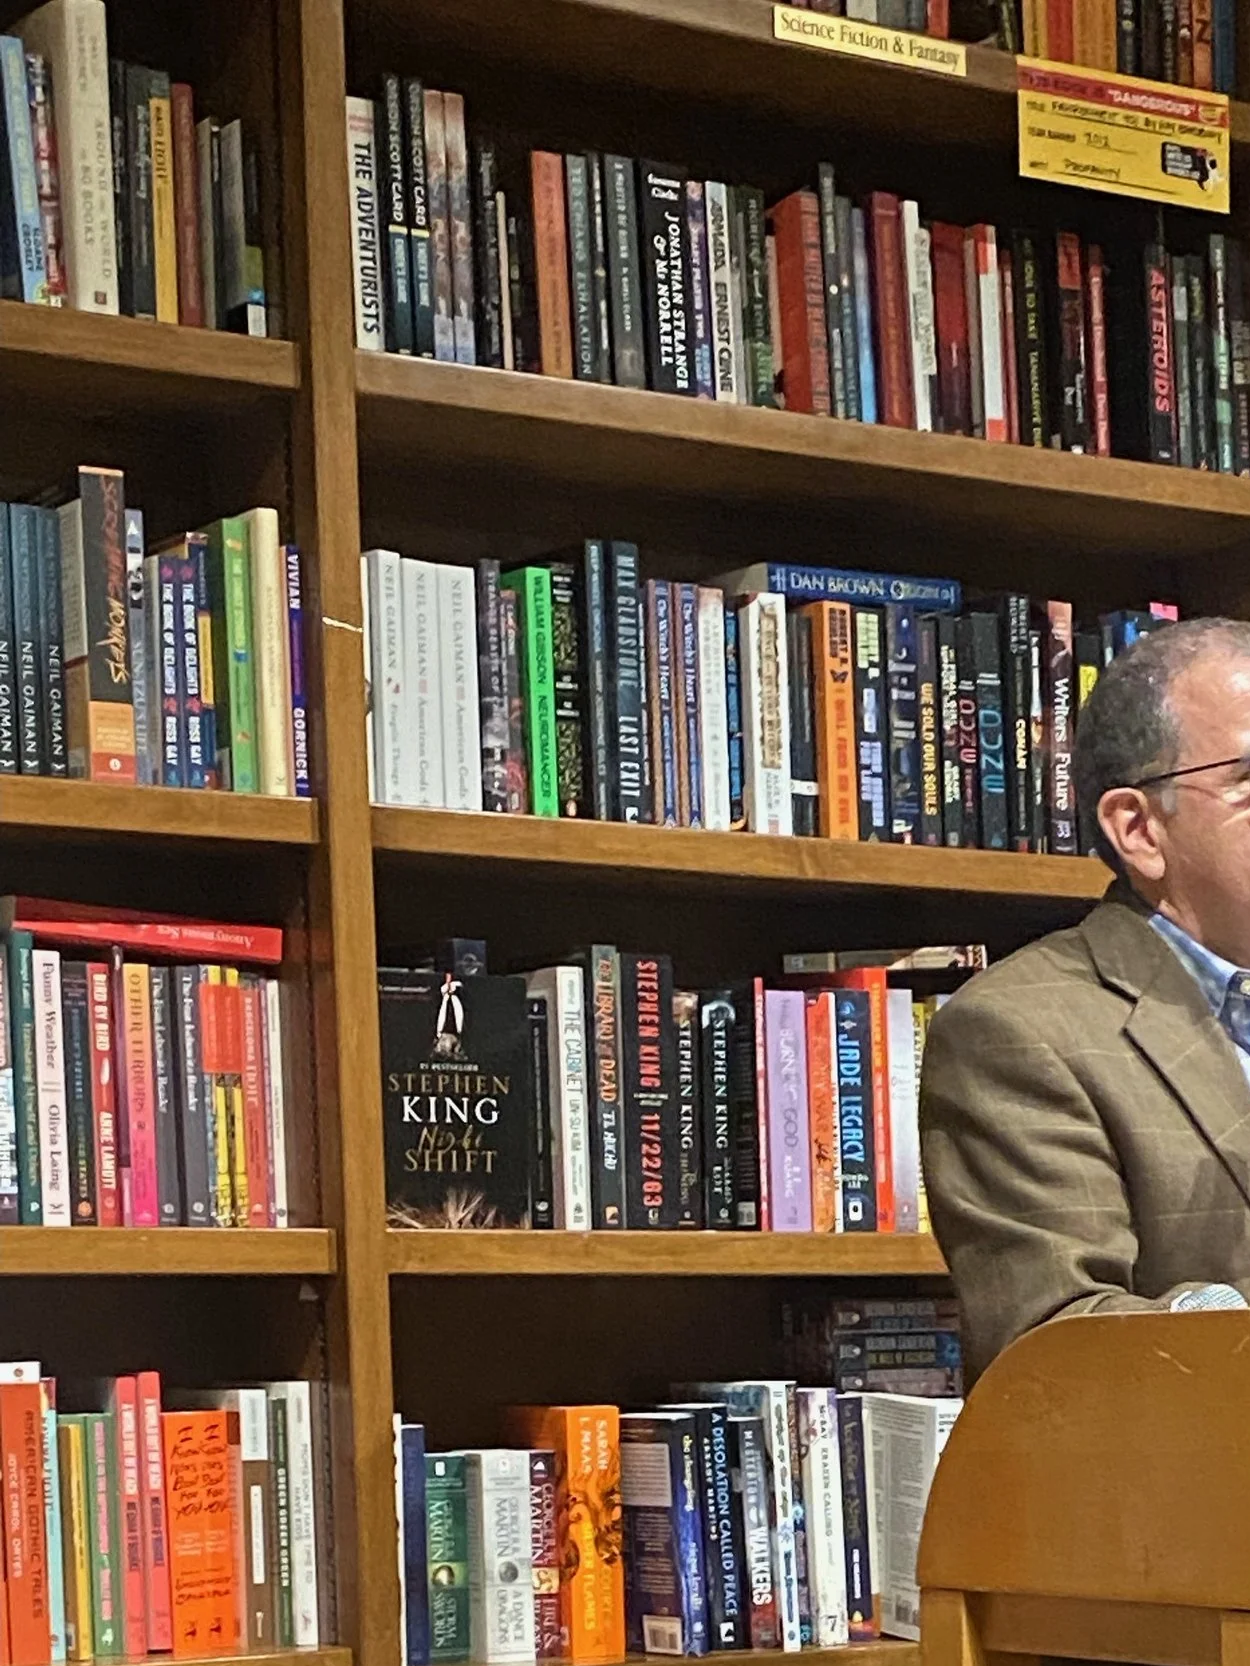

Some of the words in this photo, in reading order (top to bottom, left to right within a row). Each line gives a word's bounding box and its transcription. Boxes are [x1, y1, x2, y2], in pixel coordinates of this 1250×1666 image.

[780, 12, 835, 42] Science
[839, 24, 889, 53] Fiction
[893, 35, 905, 54] &
[908, 39, 960, 70] Fantasy
[353, 142, 372, 179] THE
[391, 182, 403, 222] CARD
[413, 184, 426, 227] CARD
[664, 211, 684, 302] JONATHAN
[710, 200, 728, 272] ARMADA
[357, 188, 380, 334] ADVENTURISTS
[656, 283, 674, 367] NORRELL
[714, 280, 730, 345] ERNEST
[672, 305, 688, 389] STRANGE
[1151, 268, 1172, 413] ASTEROIDS
[718, 346, 734, 393] CLINE
[287, 553, 301, 610] VIVIAN
[384, 563, 395, 601] NEIL
[415, 571, 426, 610] NEIL
[616, 554, 635, 589] MAX
[790, 572, 825, 590] DAN
[827, 577, 885, 596] BROWN
[163, 604, 174, 630] BOOK
[183, 604, 195, 630] BOOK
[451, 579, 463, 618] NEIL
[532, 574, 547, 632] WILLIAM
[96, 600, 130, 684] MONKEYS
[164, 631, 175, 646] OF
[184, 631, 197, 646] OF
[384, 604, 397, 669] GAIMAN
[416, 614, 427, 673] GAIMAN
[452, 620, 465, 682] GAIMAN
[535, 633, 548, 685] GIBSON
[617, 592, 639, 690] GLADSTONE
[22, 641, 34, 680] NEIL
[49, 644, 61, 683] NEIL
[164, 648, 176, 695] DELIGHTS
[185, 648, 199, 695] DELIGHTS
[920, 682, 935, 705] WE
[1053, 677, 1070, 743] Writers
[0, 684, 12, 752] GAIMAN
[23, 684, 37, 752] GAIMAN
[50, 688, 64, 756] GAIMAN
[166, 715, 178, 743] ROSS
[188, 715, 201, 743] ROSS
[618, 716, 639, 756] LAST
[921, 706, 936, 742] SOLD
[167, 745, 179, 766] GAY
[190, 745, 202, 766] GAY
[293, 706, 308, 781] GORNICK
[537, 694, 552, 800] NEUROMANCER
[923, 742, 937, 772] OUR
[1015, 717, 1028, 770] CONAN
[619, 759, 640, 797] EXIT
[923, 773, 939, 816] SOULS
[1054, 752, 1072, 812] Future
[42, 961, 54, 1007] Funny
[129, 972, 144, 1032] OTHER
[636, 960, 659, 1038] STEPHEN
[564, 1009, 583, 1033] THE
[595, 981, 616, 1041] LIBRARY
[46, 1011, 60, 1069] Weather
[96, 1023, 110, 1051] BIRD
[678, 1019, 692, 1097] STEPHEN
[712, 1019, 728, 1098] STEPHEN
[837, 1033, 862, 1087] JADE
[131, 1039, 147, 1117] TERRORS
[388, 1073, 511, 1095] STEPHEN
[565, 1037, 584, 1096] CABINET
[600, 1057, 617, 1103] DEAD
[639, 1045, 661, 1089] KING
[49, 1104, 60, 1146] Olivia
[100, 1111, 113, 1142] ANNE
[402, 1096, 500, 1124] KING
[679, 1104, 694, 1150] KING
[715, 1104, 729, 1149] KING
[783, 1106, 800, 1149] GOD
[841, 1095, 865, 1164] LEGACY
[49, 1151, 60, 1192] Laing
[101, 1144, 116, 1189] LAMOTT
[404, 1149, 498, 1173] SHIFT
[641, 1113, 662, 1207] 11/22/63
[711, 1411, 723, 1424] A
[25, 1410, 38, 1499] AMERICAN
[596, 1419, 609, 1471] SARAH
[820, 1447, 832, 1489] KRAKEN
[7, 1453, 17, 1493] JOYCE
[277, 1467, 288, 1507] GREEN
[712, 1426, 732, 1516] DESOLATION
[9, 1496, 20, 1537] CAROL
[28, 1506, 41, 1558] GOTHIC
[278, 1508, 289, 1547] GREEN
[430, 1498, 447, 1563] MARTIN
[496, 1497, 511, 1559] MARTIN
[823, 1491, 834, 1537] CALLING
[719, 1519, 734, 1571] CALLED
[750, 1525, 774, 1606] WALKERS
[31, 1567, 44, 1620] TALES
[722, 1573, 738, 1618] PEACE
[511, 1601, 526, 1641] DANCE
